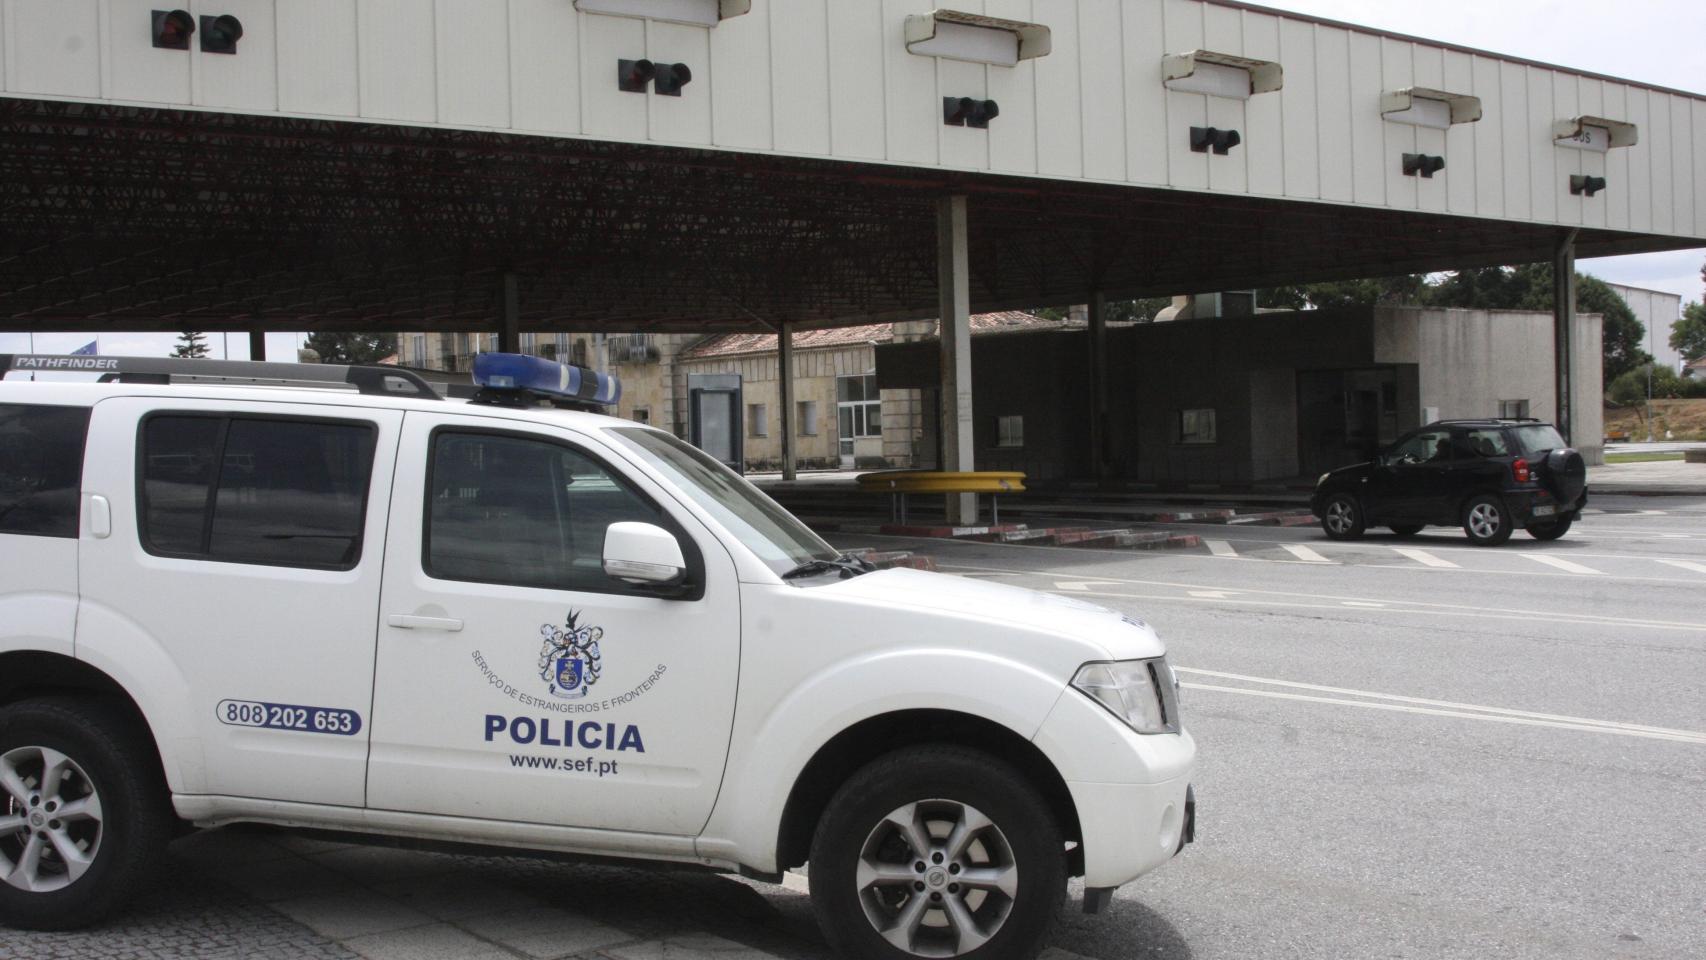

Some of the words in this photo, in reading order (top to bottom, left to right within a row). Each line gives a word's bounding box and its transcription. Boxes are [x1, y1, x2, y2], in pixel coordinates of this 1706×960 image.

[16, 357, 118, 369] PATHFINDER
[471, 650, 503, 689] SERVIÇO
[503, 683, 518, 699] DE
[518, 692, 600, 714] ESTRANGEIROS
[602, 700, 609, 711] E
[611, 663, 667, 707] FRONTEIRAS
[227, 703, 263, 724] 808
[269, 707, 308, 728] 202
[314, 711, 352, 732] 653
[485, 714, 646, 753] POLICIA
[510, 755, 618, 777] www.sef.pt
